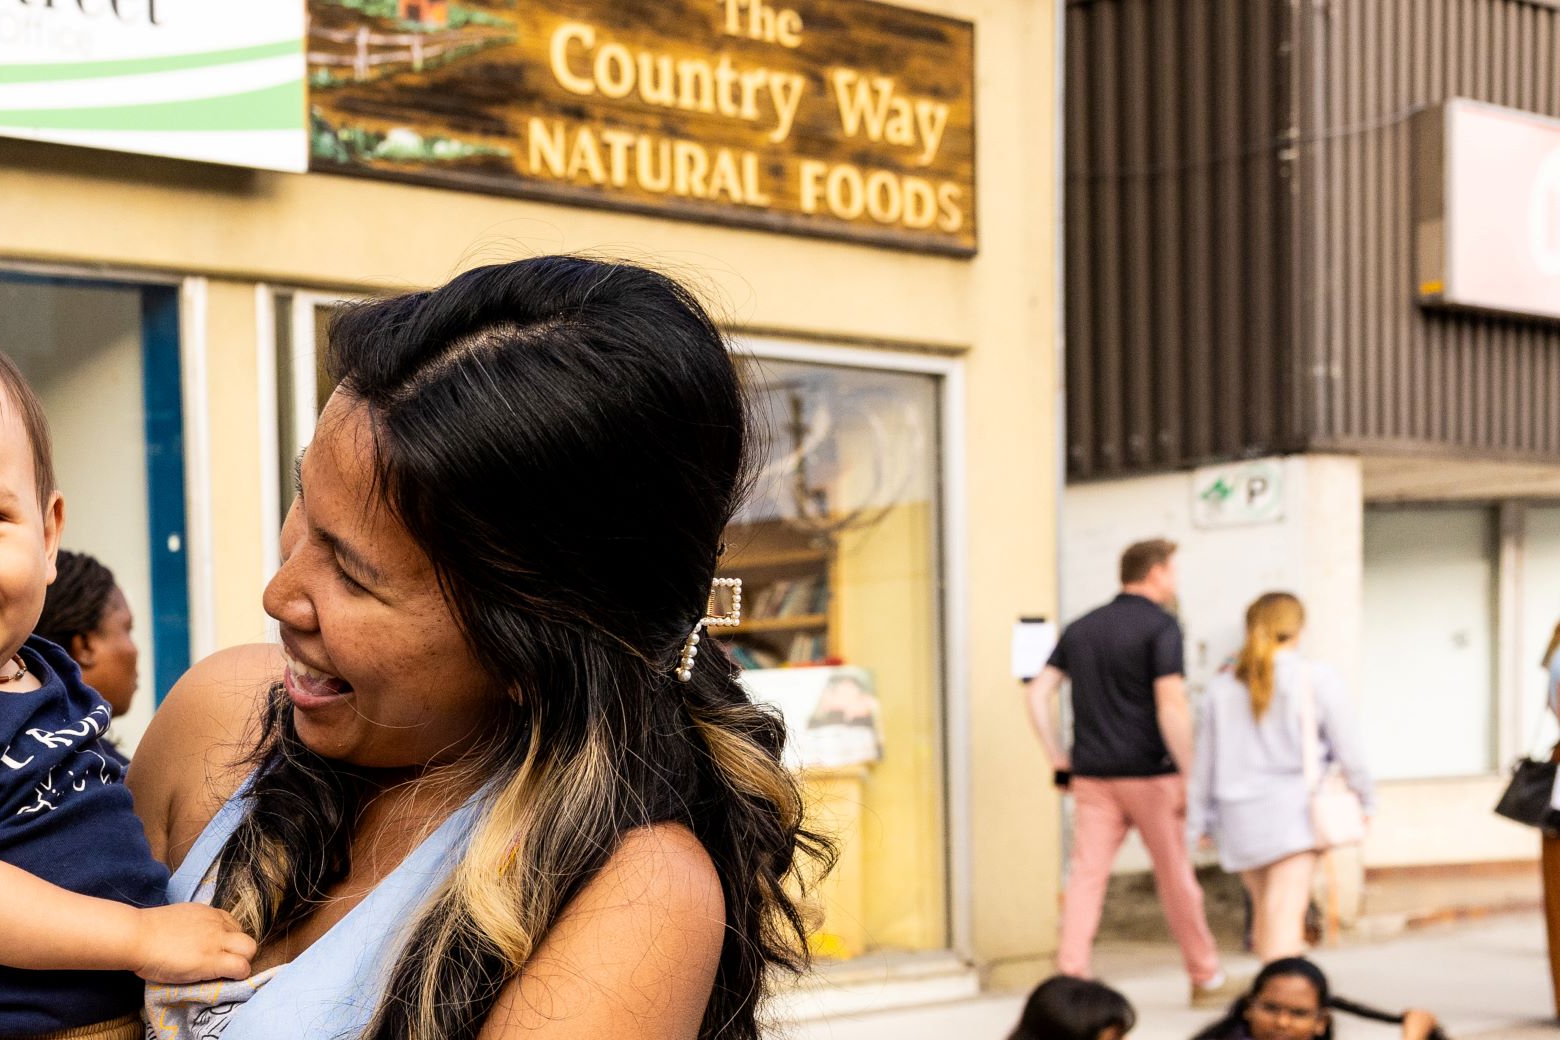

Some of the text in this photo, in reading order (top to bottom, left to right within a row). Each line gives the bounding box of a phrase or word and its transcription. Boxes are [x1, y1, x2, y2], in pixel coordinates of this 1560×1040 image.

[717, 0, 803, 48] The
[550, 22, 950, 166] Country Way
[527, 117, 963, 233] NATURAL FOODS
